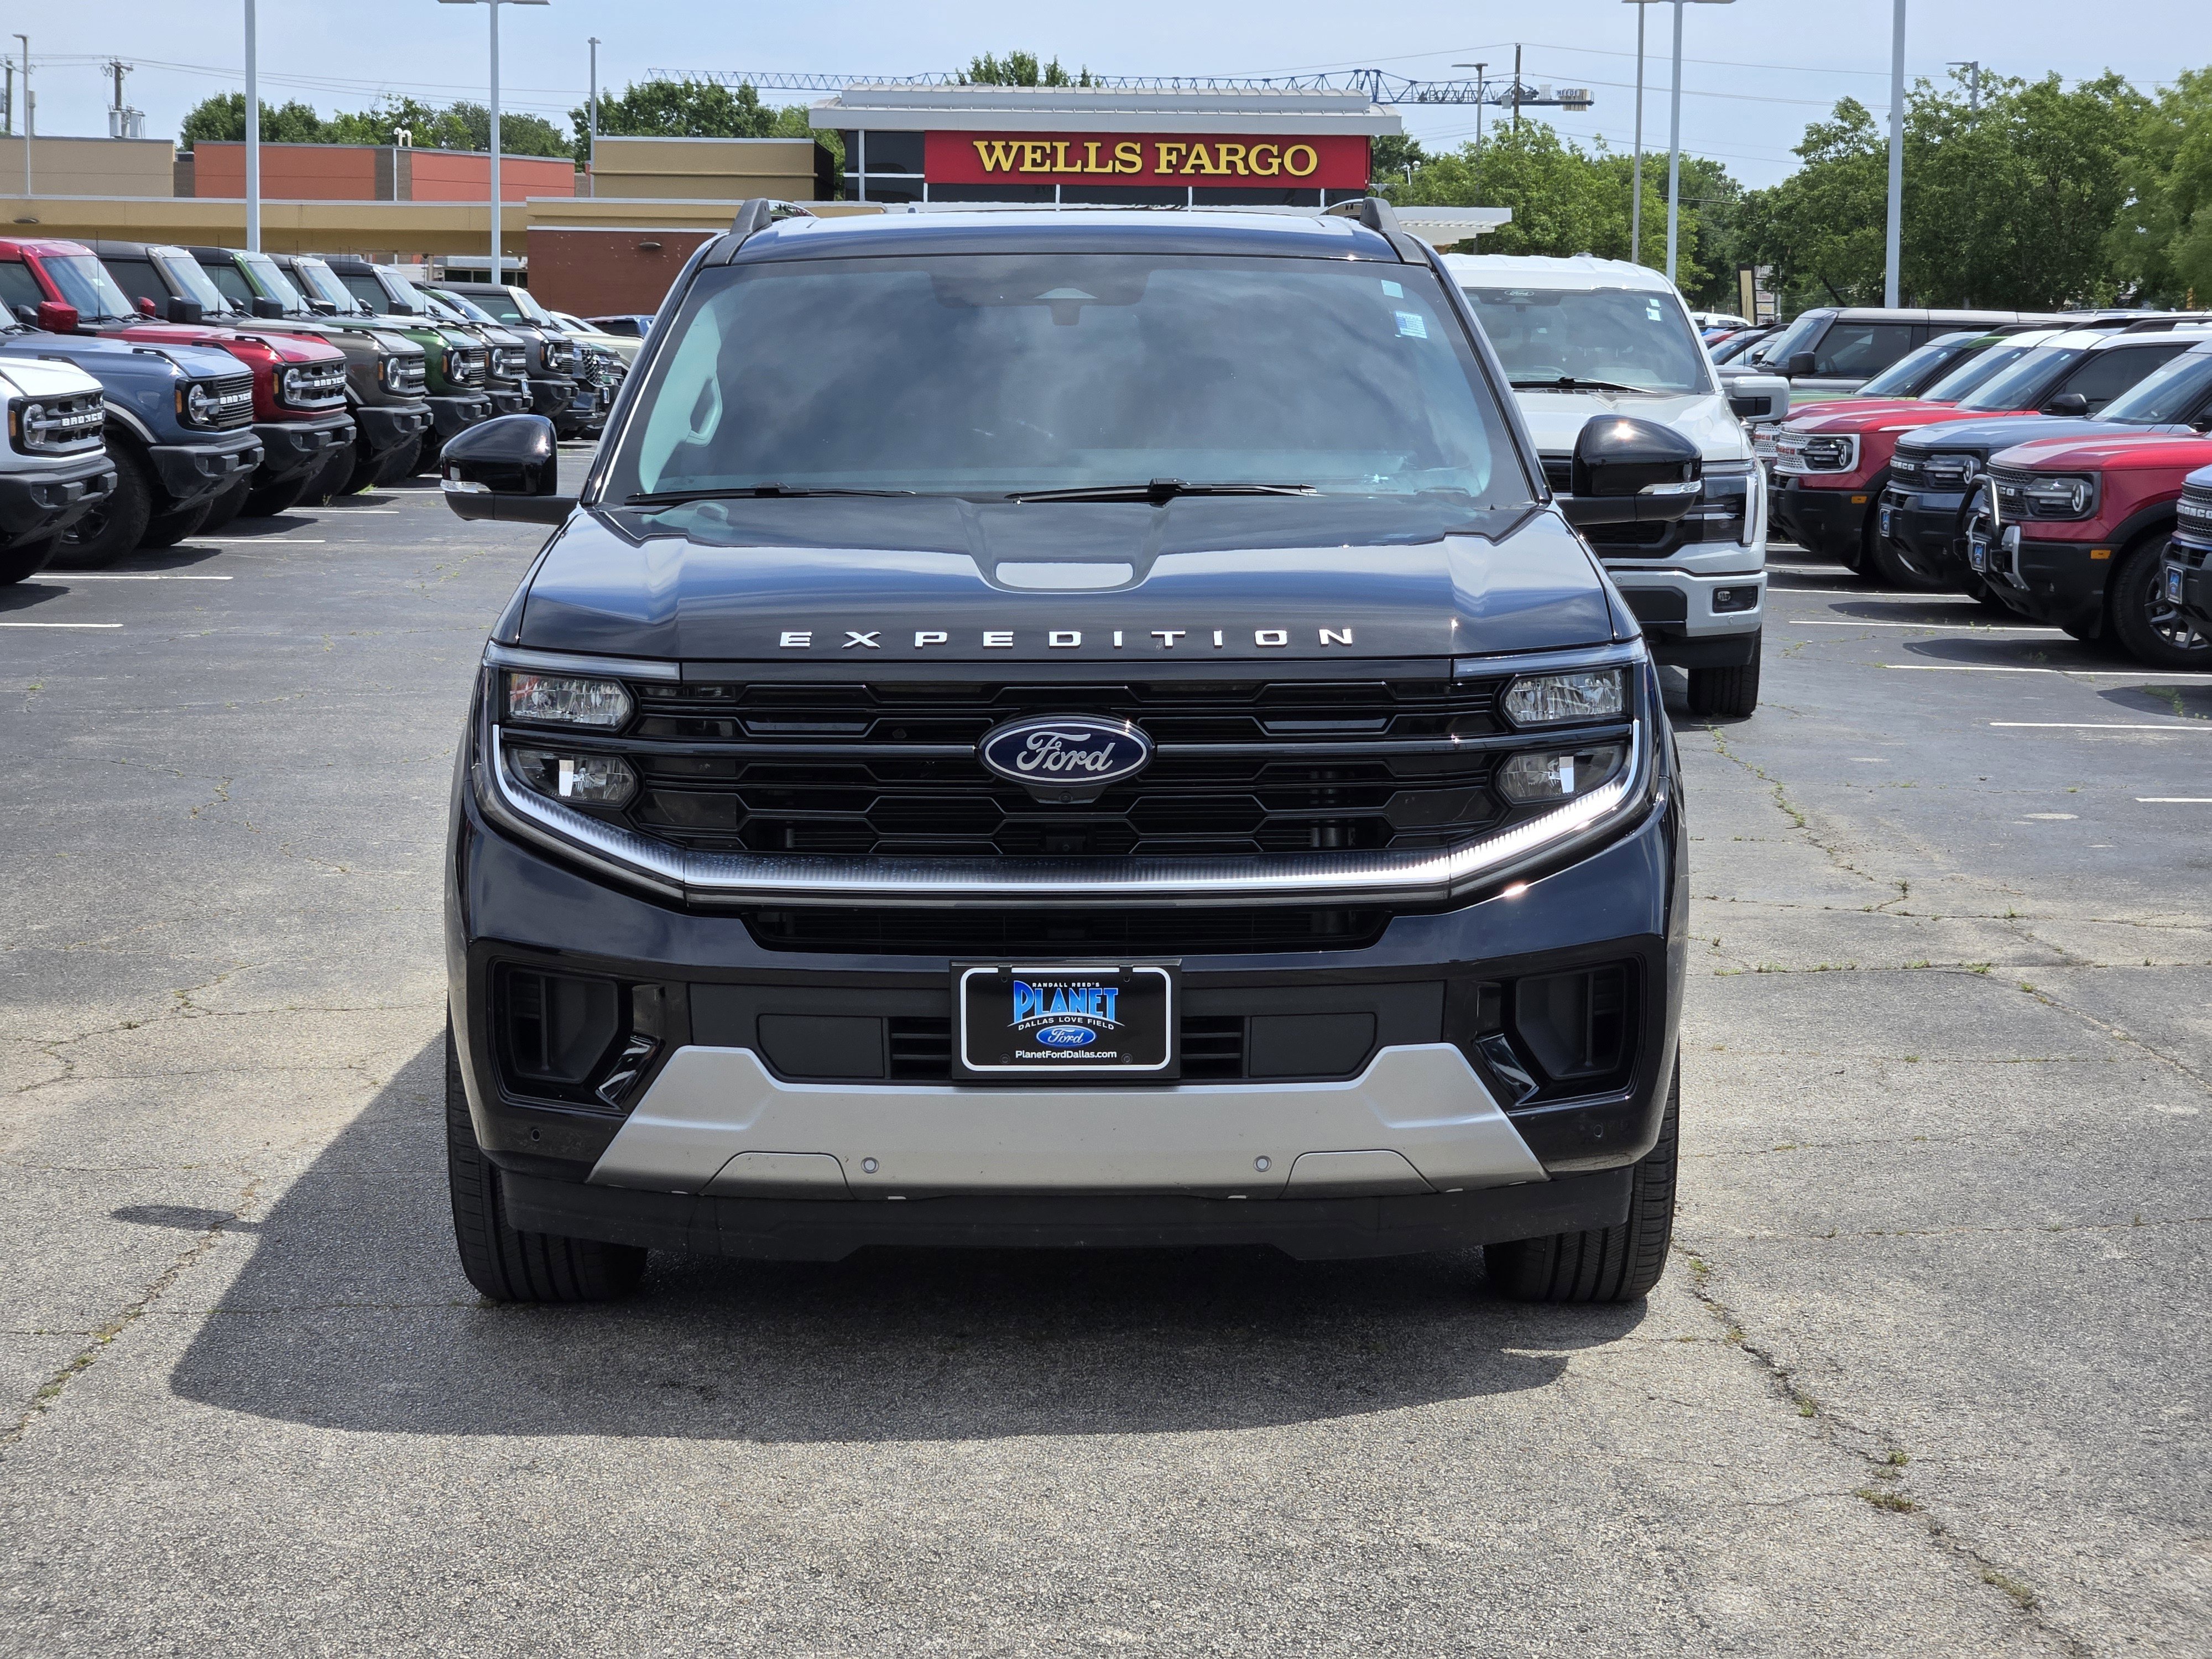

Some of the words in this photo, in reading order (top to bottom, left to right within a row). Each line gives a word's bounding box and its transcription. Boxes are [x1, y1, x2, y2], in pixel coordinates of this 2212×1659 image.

[973, 140, 1143, 173] WELLS
[1154, 142, 1318, 176] FARGO
[61, 412, 103, 426] BRONCO
[779, 628, 1354, 649] EXPEDITION
[1015, 731, 1115, 772] Ford
[1014, 980, 1118, 1023] PLANET
[1018, 1018, 1055, 1031] DALLAS
[1087, 1019, 1115, 1030] FIELD
[1047, 1028, 1084, 1044] Ford
[1015, 1050, 1117, 1058] PlanetFordDallas.com
